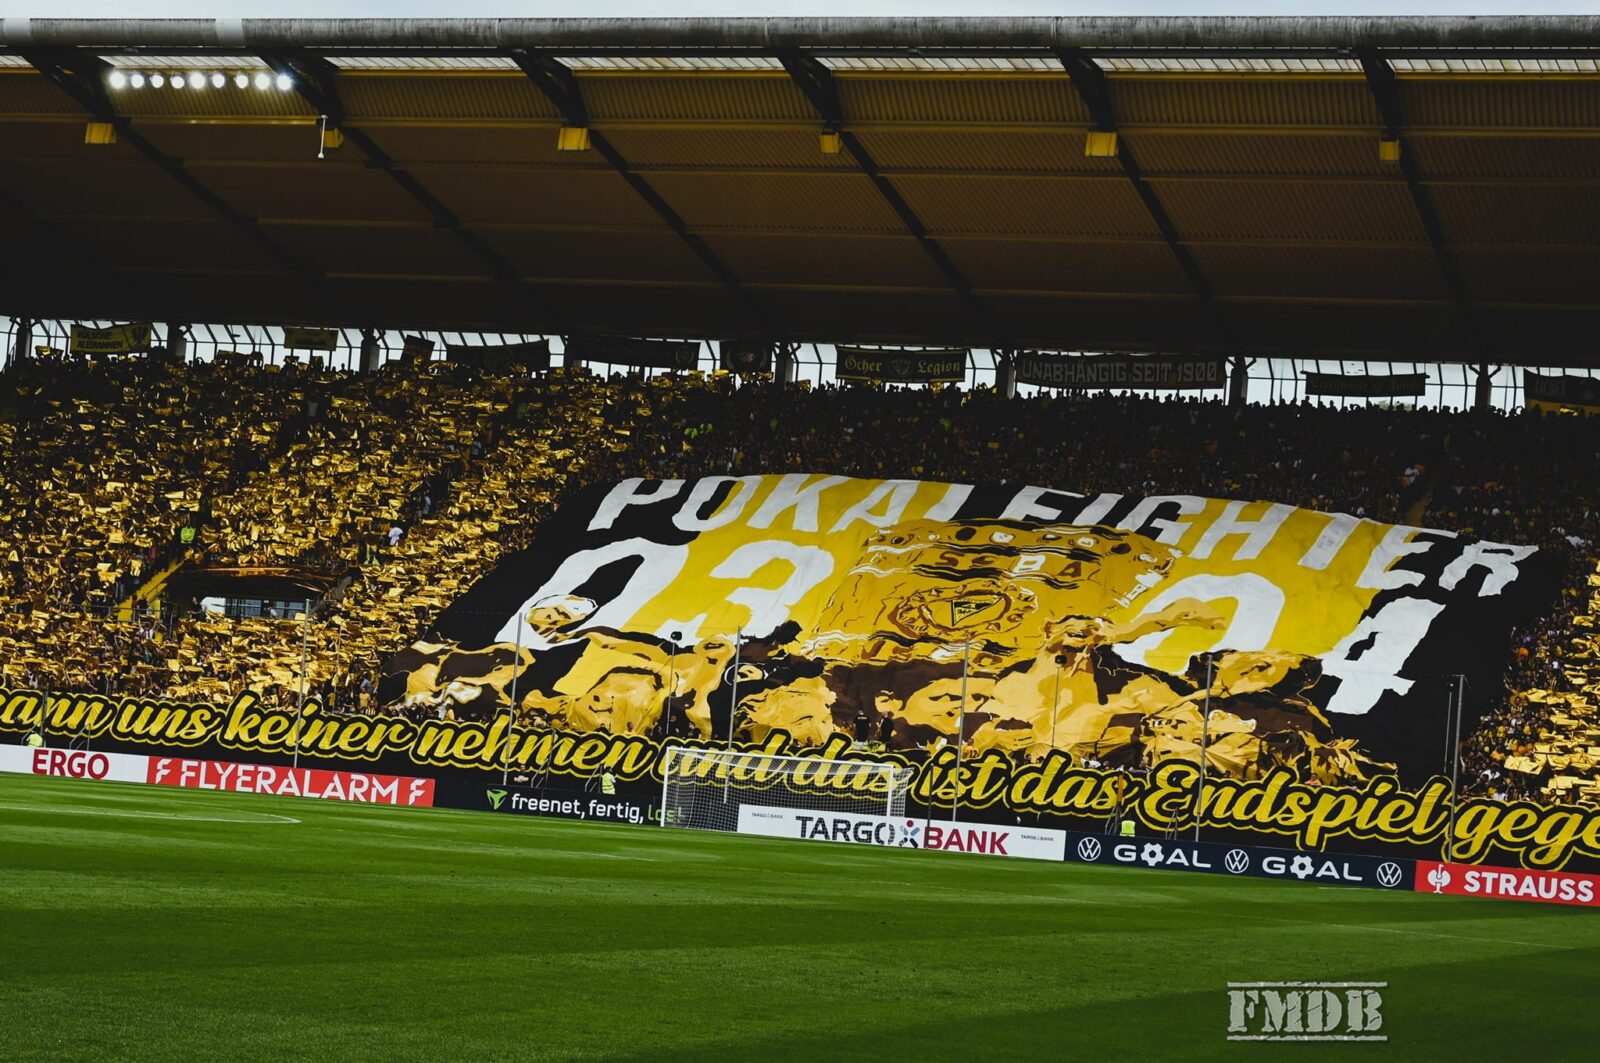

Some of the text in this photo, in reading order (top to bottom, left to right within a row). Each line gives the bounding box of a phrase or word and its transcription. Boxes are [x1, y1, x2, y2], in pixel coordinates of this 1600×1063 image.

[844, 354, 961, 375] Öcher Legion
[1022, 357, 1217, 382] UNABHÄNGIG SEIT 1900
[0, 693, 113, 731] ann
[120, 702, 219, 739] uns
[224, 695, 415, 752] keiner
[418, 711, 652, 772] nehmen
[658, 733, 790, 783] und
[792, 738, 903, 793] das
[927, 751, 1009, 800] ist
[1012, 755, 1125, 811] das
[1142, 764, 1447, 848] Endspiel
[32, 749, 110, 780] ERGO
[180, 760, 398, 806] FLYERALARM
[511, 793, 586, 820] freenet,
[588, 800, 644, 824] fertig,
[795, 815, 1010, 855] TARGO BANK
[1463, 870, 1595, 903] STRAUSS
